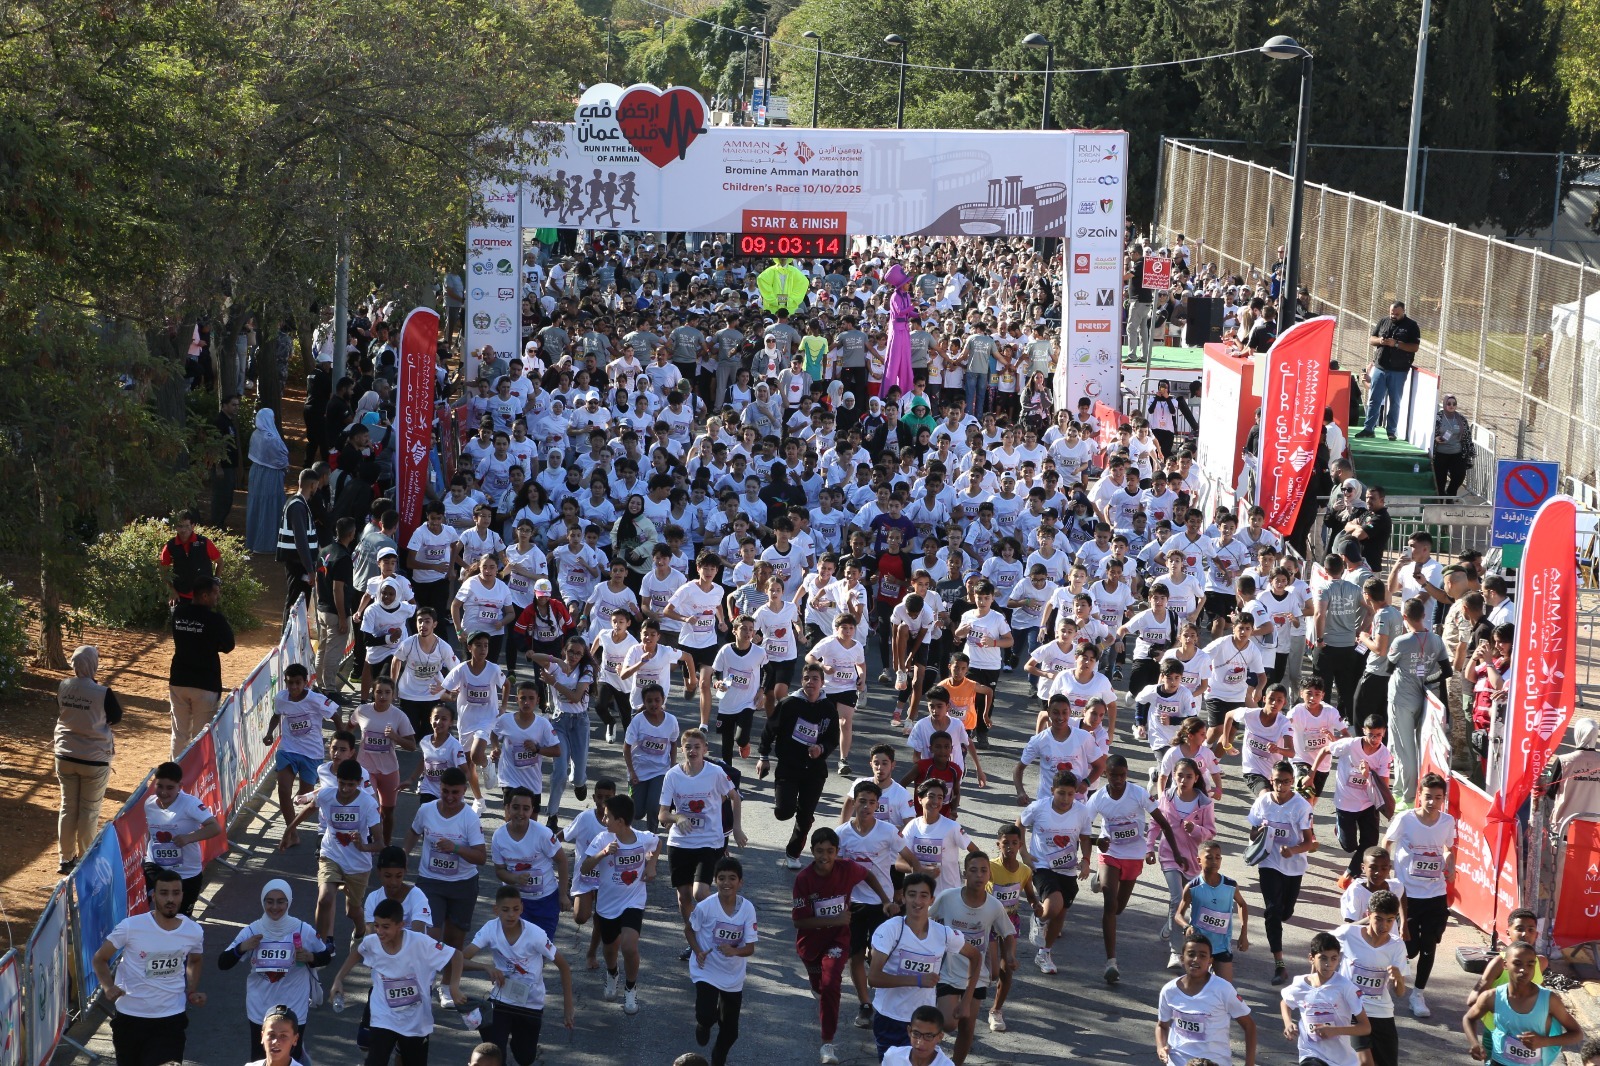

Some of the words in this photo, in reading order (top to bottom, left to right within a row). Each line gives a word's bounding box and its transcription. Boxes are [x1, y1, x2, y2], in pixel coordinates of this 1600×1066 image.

[579, 101, 612, 123] في
[578, 126, 620, 144] عمان
[599, 145, 607, 153] IN
[723, 140, 770, 149] AMMAN
[1078, 144, 1101, 153] RUN
[609, 155, 640, 163] AMMAN
[725, 166, 767, 175] Bromine
[770, 167, 809, 177] Amman
[812, 168, 859, 177] Marathon
[722, 182, 773, 192] Children's
[775, 184, 800, 193] Race
[803, 185, 862, 194] 10/10/2025
[751, 216, 787, 229] START
[789, 218, 799, 229] &
[802, 218, 839, 229] FINISH
[1088, 226, 1118, 238] zain
[473, 238, 513, 247] aramex
[1077, 322, 1110, 330] ENERGY
[1279, 361, 1295, 411] عمان
[1303, 359, 1313, 415] MARATHON
[1308, 359, 1320, 415] AMMAN
[1275, 415, 1292, 464] ماراثون
[1501, 511, 1525, 525] الوقوف
[1495, 530, 1516, 542] الخاصة
[482, 611, 498, 619] 9787
[1529, 574, 1542, 651] عمان
[1550, 568, 1563, 652] AMMAN
[697, 619, 713, 627] 9457
[1146, 631, 1163, 640] 9728
[768, 644, 785, 653] 9515
[469, 690, 488, 698] 9610
[1524, 656, 1539, 732] ماراثون
[1158, 705, 1176, 713] 9754
[798, 725, 817, 738] 9573
[367, 737, 388, 746] 9581
[645, 741, 665, 751] 9794
[1307, 737, 1327, 747] 5536
[334, 813, 356, 822] 9529
[1114, 828, 1136, 840] 9686
[156, 849, 179, 859] 9593
[916, 844, 939, 855] 9560
[432, 858, 455, 869] 9592
[618, 854, 641, 865] 9590
[1052, 853, 1073, 868] 9625
[1416, 861, 1439, 871] 9745
[996, 890, 1017, 900] 9672
[819, 904, 843, 916] 9738
[1202, 914, 1226, 928] 9683
[718, 929, 742, 940] 9761
[261, 949, 287, 960] 9619
[151, 958, 178, 970] 5743
[904, 959, 931, 973] 9732
[1355, 975, 1382, 988] 9718
[388, 986, 415, 999] 9758
[1177, 1018, 1200, 1032] 9735
[1509, 1045, 1537, 1059] 9685
